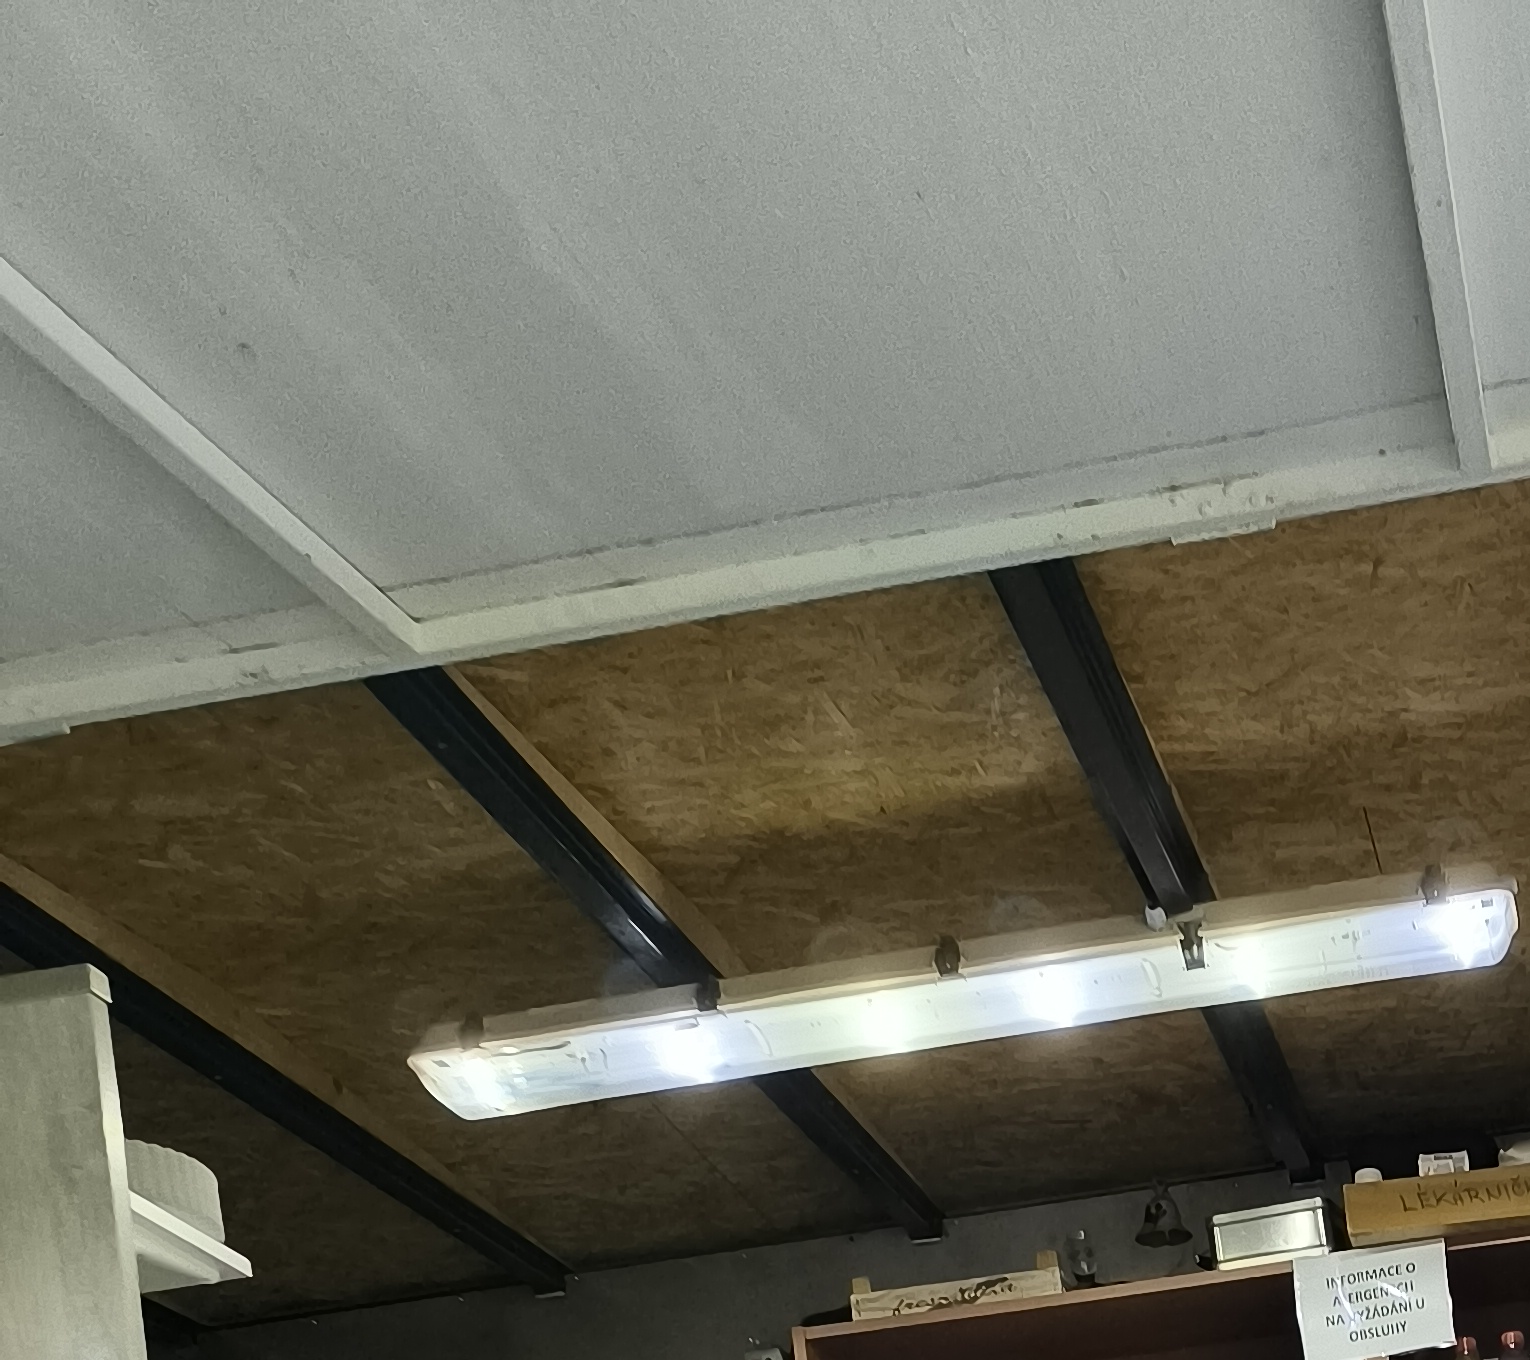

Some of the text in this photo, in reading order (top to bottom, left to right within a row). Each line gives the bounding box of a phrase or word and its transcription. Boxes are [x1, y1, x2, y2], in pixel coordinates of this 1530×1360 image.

[1406, 1262, 1415, 1274] O
[1326, 1315, 1345, 1327] NA
[1416, 1298, 1425, 1310] U
